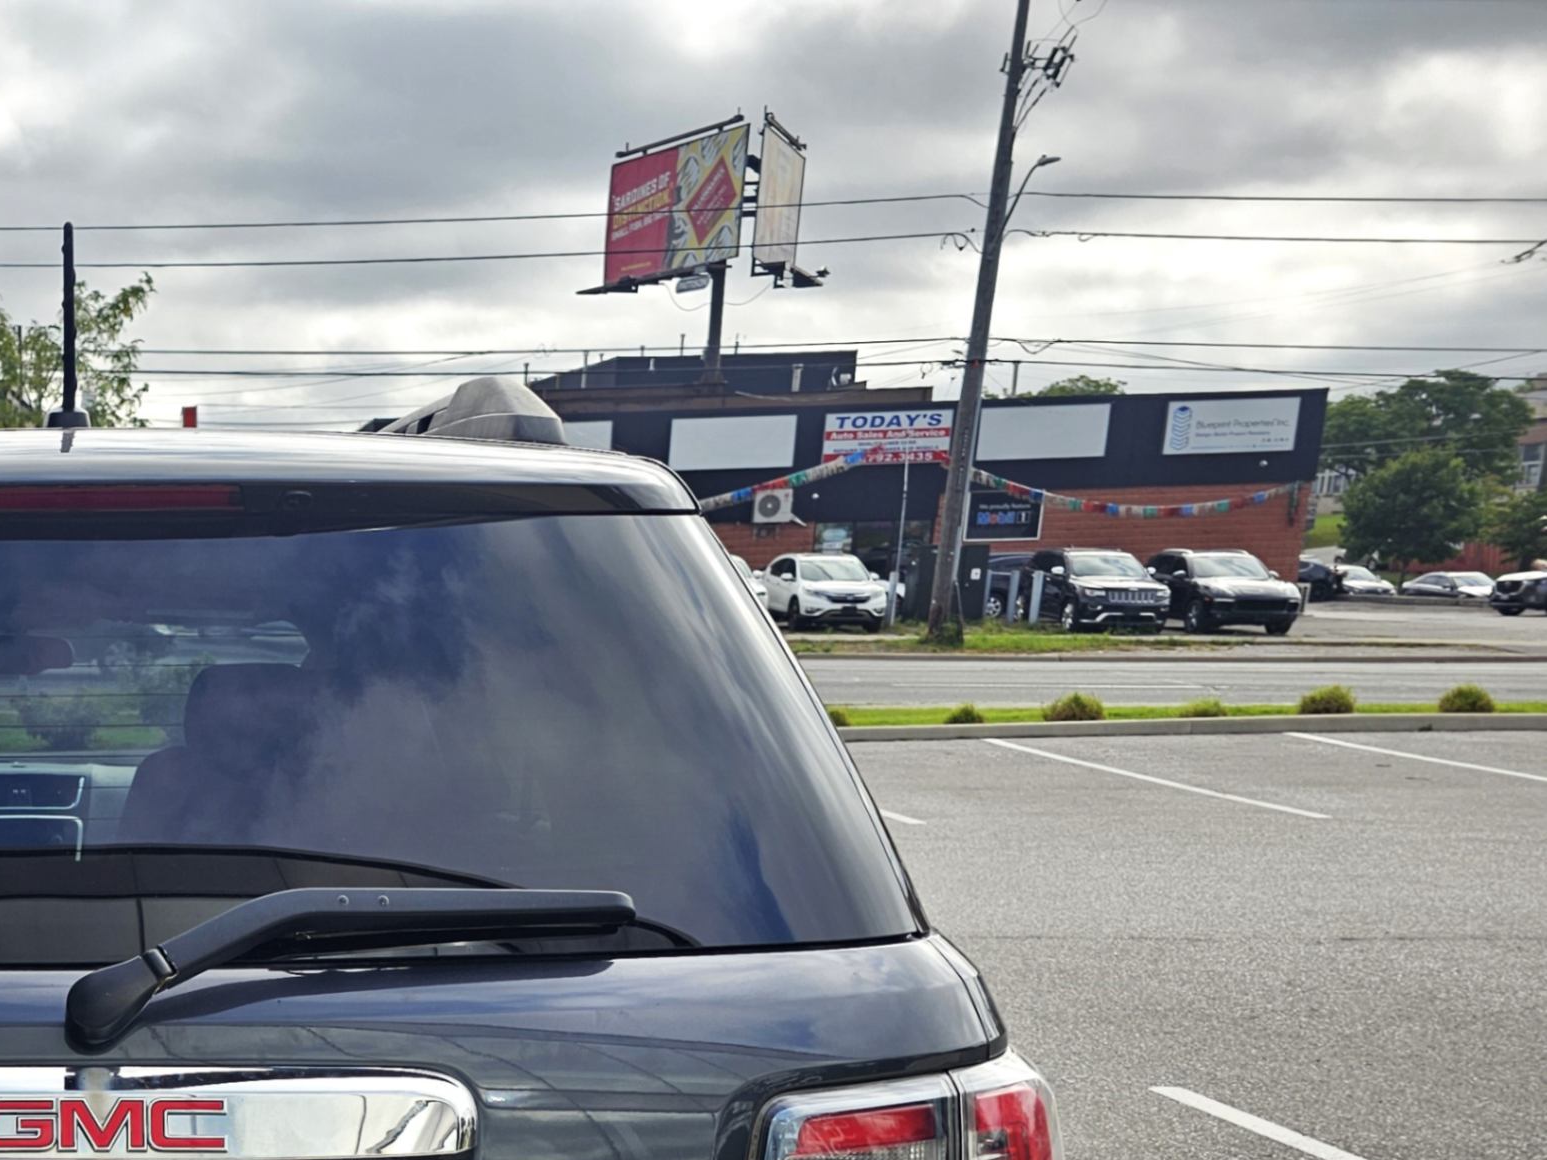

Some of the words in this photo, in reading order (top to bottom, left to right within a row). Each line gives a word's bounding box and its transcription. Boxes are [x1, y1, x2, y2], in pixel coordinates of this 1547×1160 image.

[658, 171, 671, 190] OF
[836, 413, 943, 429] TODAY'S
[830, 432, 855, 440] Auto
[857, 430, 884, 439] Sales
[885, 430, 906, 439] And
[908, 429, 946, 437] Service
[977, 511, 1015, 525] Mobil
